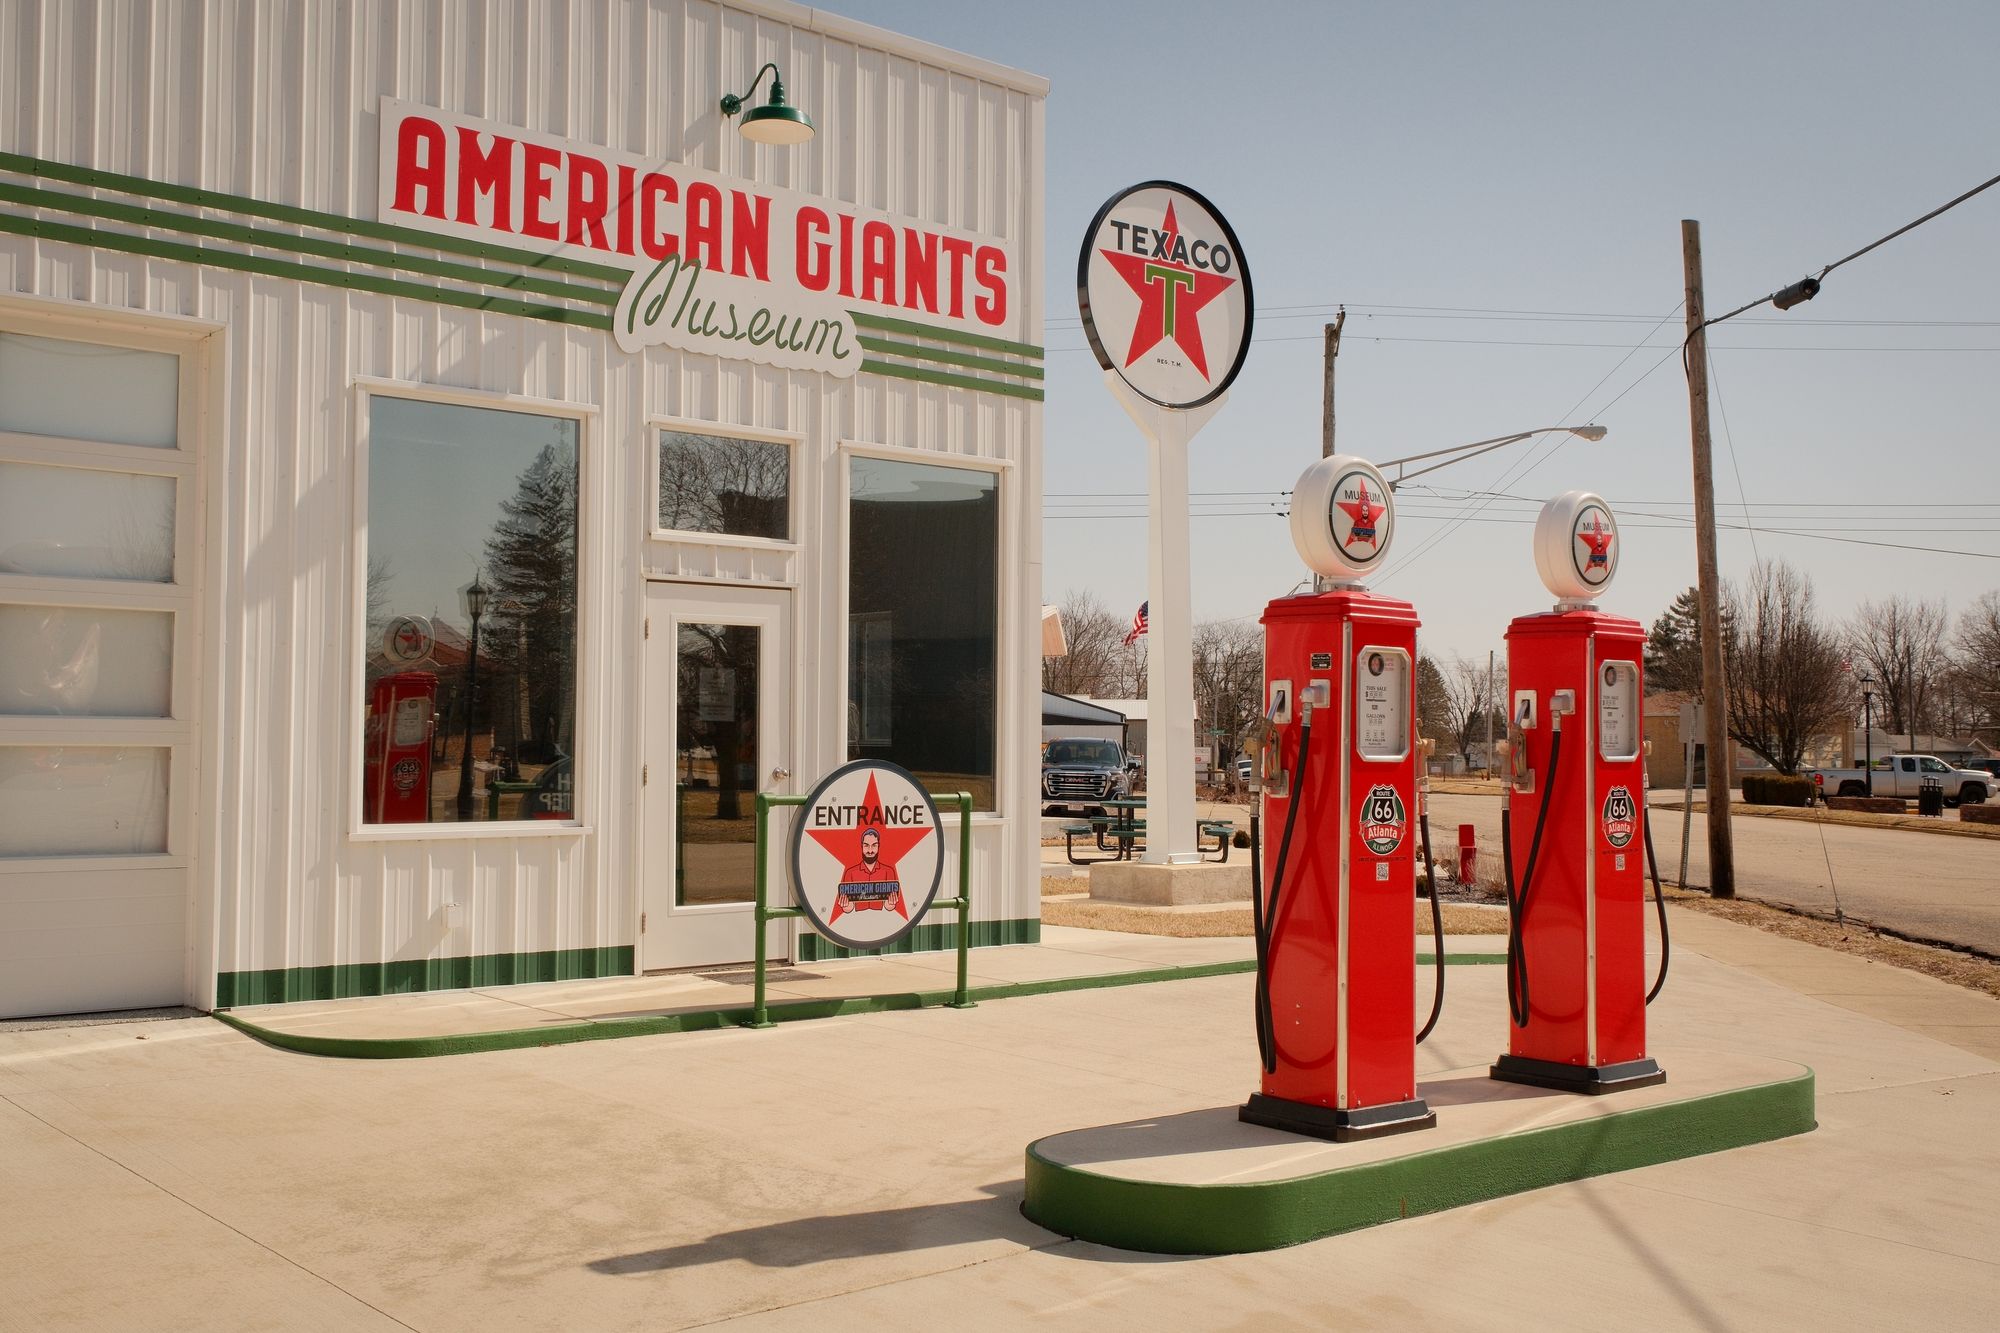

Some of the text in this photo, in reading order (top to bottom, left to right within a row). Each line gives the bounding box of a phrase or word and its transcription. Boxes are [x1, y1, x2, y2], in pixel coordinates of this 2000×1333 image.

[390, 115, 1008, 326] AMERICAN GIANTS
[1110, 219, 1231, 274] TEXACO
[626, 253, 849, 359] Museum
[1145, 263, 1195, 338] T
[1344, 489, 1381, 502] MUSEUM
[1583, 522, 1610, 532] MUSEUM
[815, 805, 924, 826] ENTRANCE
[1374, 800, 1392, 819] 66
[1612, 800, 1626, 816] 66
[1368, 826, 1398, 839] Atlanta
[1608, 822, 1631, 834] Atlanta
[1372, 842, 1393, 852] ILLINOIS
[839, 884, 874, 895] AMERICAN
